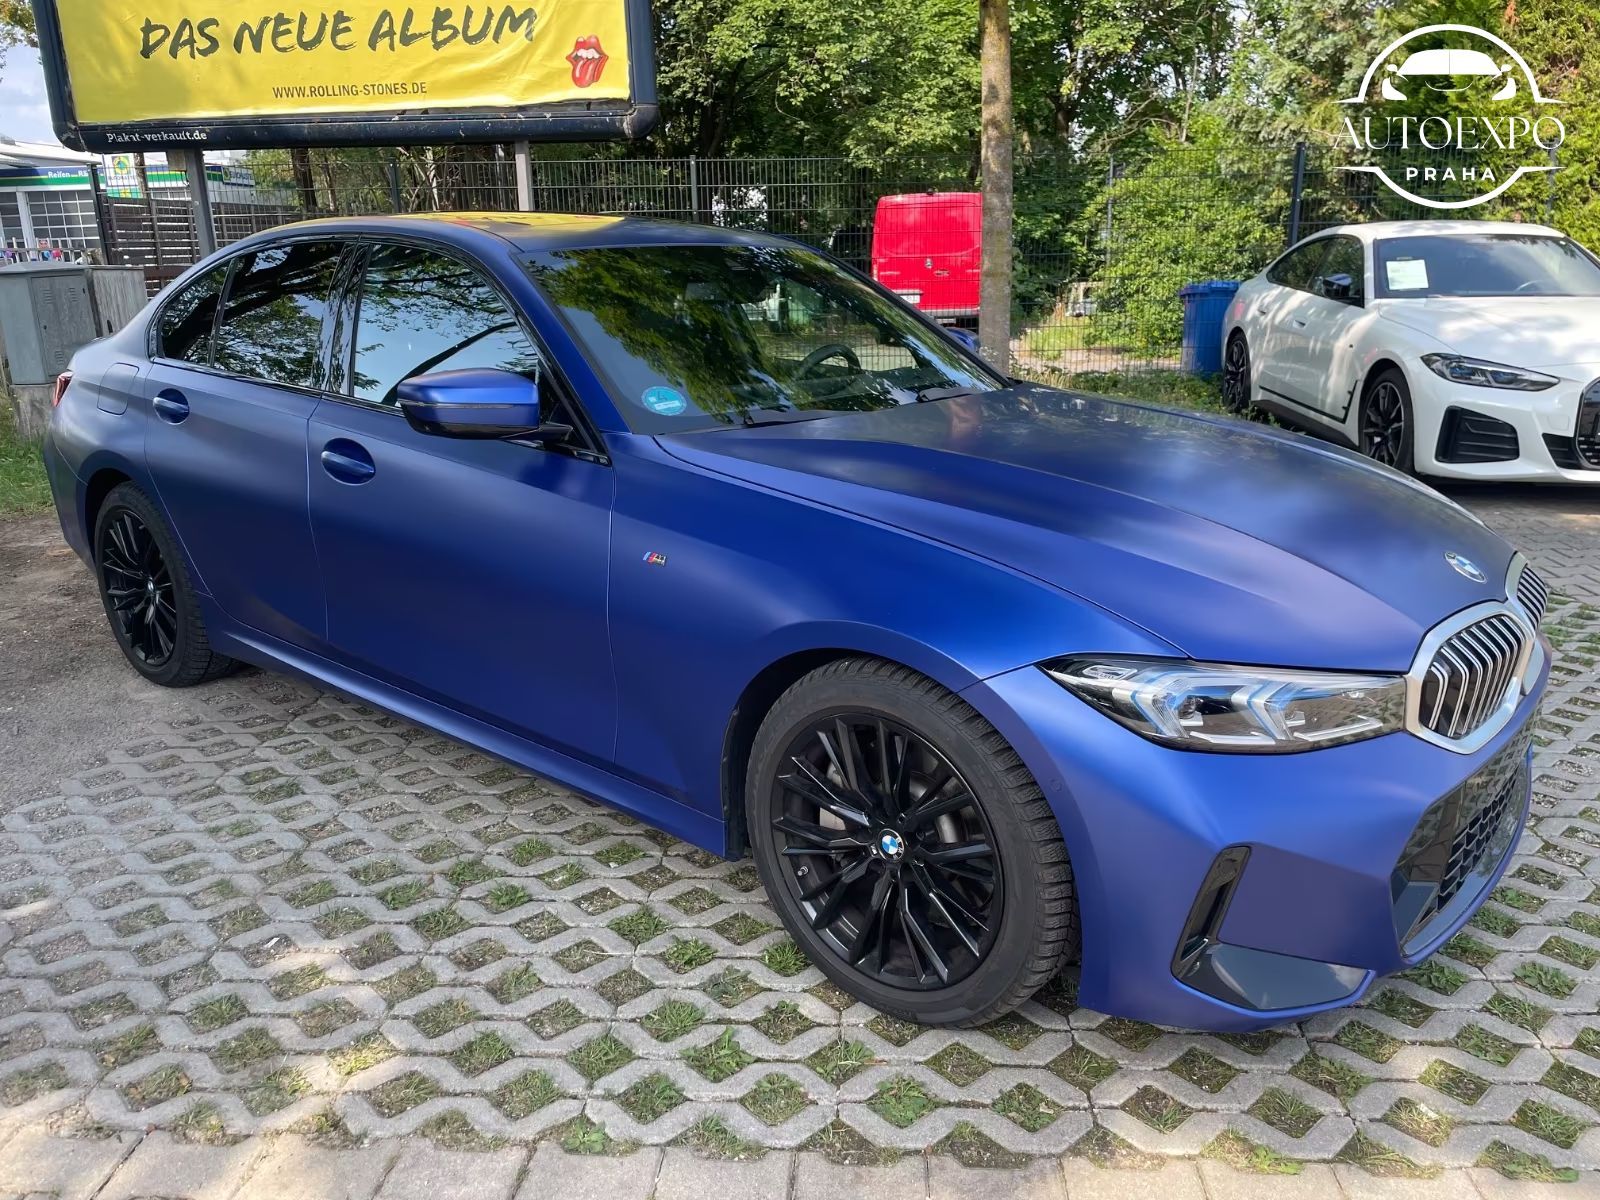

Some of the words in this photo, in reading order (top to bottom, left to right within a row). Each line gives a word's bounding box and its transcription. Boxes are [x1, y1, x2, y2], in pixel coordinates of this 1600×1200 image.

[140, 17, 220, 60] DAS
[233, 10, 357, 54] NEUE
[368, 5, 538, 51] ALBUM
[272, 82, 428, 99] WWW.ROLLING-STONES.DE
